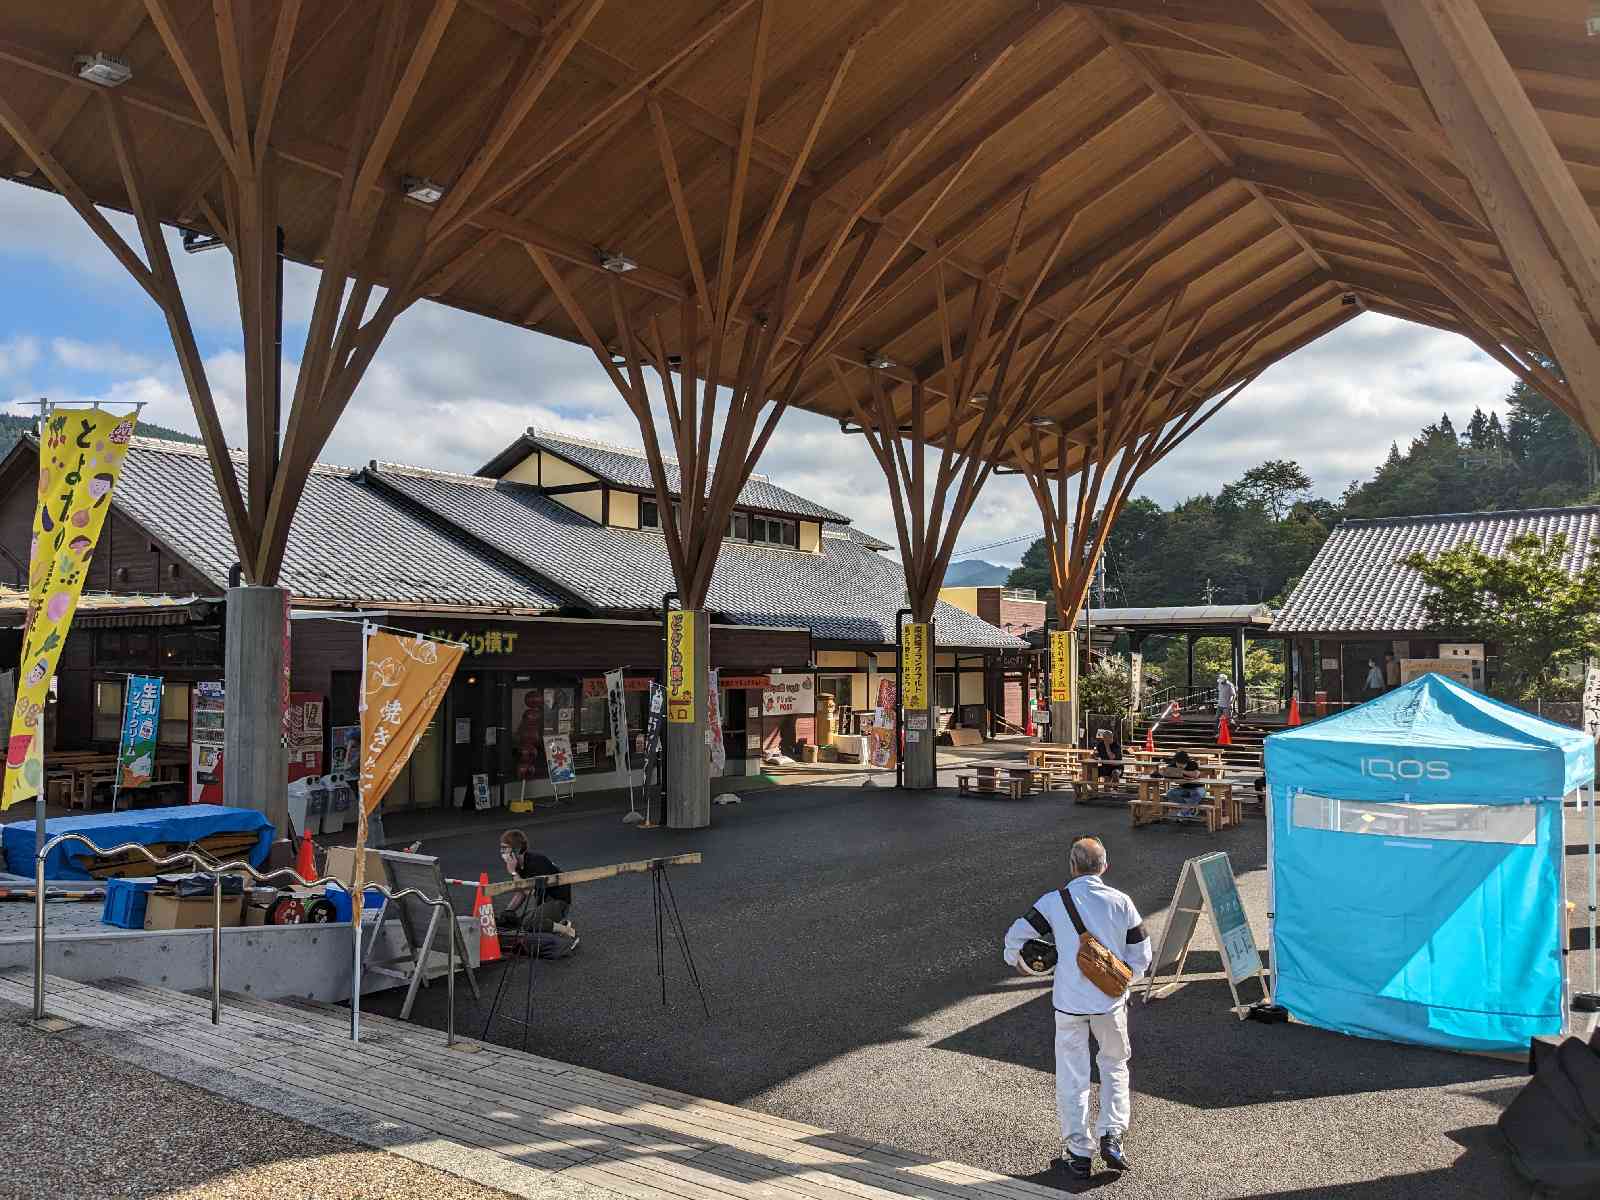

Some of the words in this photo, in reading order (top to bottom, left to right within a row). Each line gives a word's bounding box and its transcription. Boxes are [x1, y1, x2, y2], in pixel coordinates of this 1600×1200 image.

[126, 691, 141, 757] ソフトクリーム
[1360, 756, 1451, 781] IQOS
